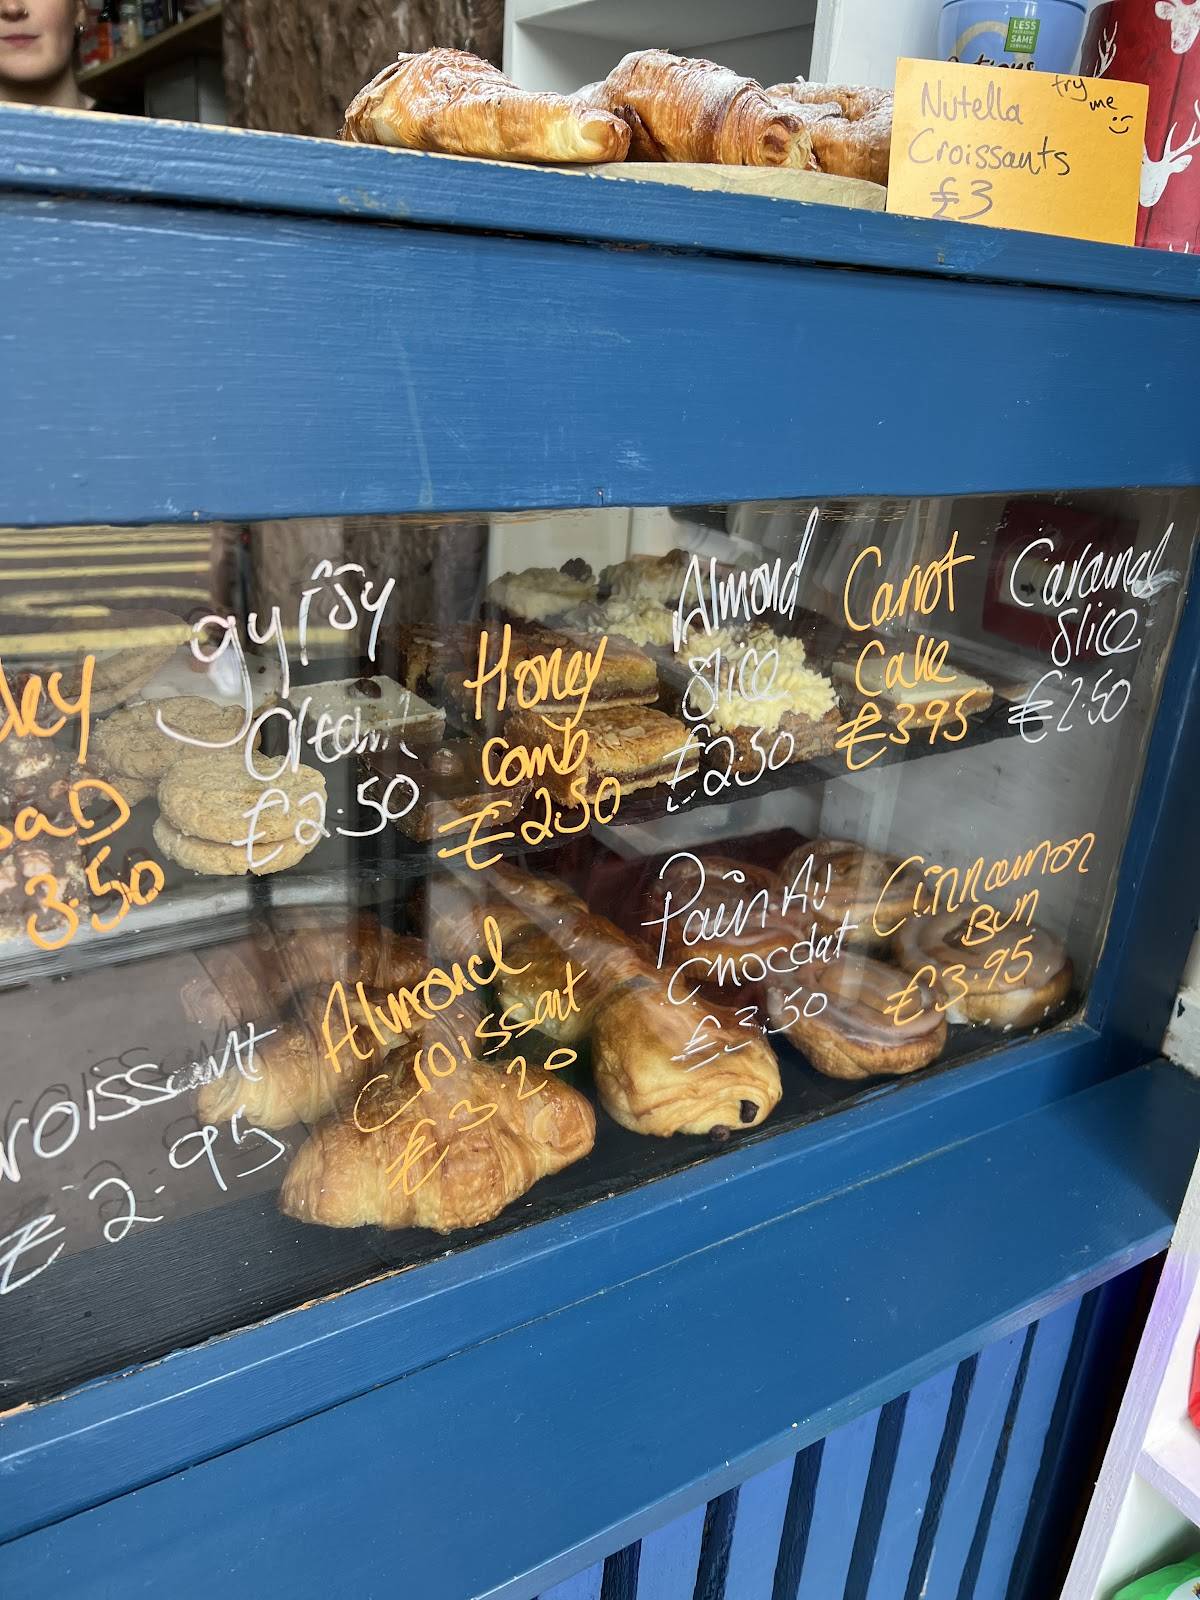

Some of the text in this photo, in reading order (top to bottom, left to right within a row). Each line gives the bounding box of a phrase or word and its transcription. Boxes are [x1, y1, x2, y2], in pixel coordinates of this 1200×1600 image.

[1010, 35, 1034, 45] SAME
[1013, 20, 1037, 31] LESS
[921, 81, 1024, 125] Nutella
[1052, 75, 1087, 101] try
[1089, 95, 1118, 112] me
[908, 128, 1071, 176] Croissants
[929, 177, 994, 220] £3
[672, 506, 819, 653] Almond
[463, 623, 608, 730] Honey
[663, 723, 795, 813] £2.50
[232, 774, 421, 868] £2.50
[24, 845, 165, 951] 3.50
[872, 832, 1097, 938] Cinnamon
[321, 915, 533, 1074] Almond
[0, 1022, 279, 1183] roissant
